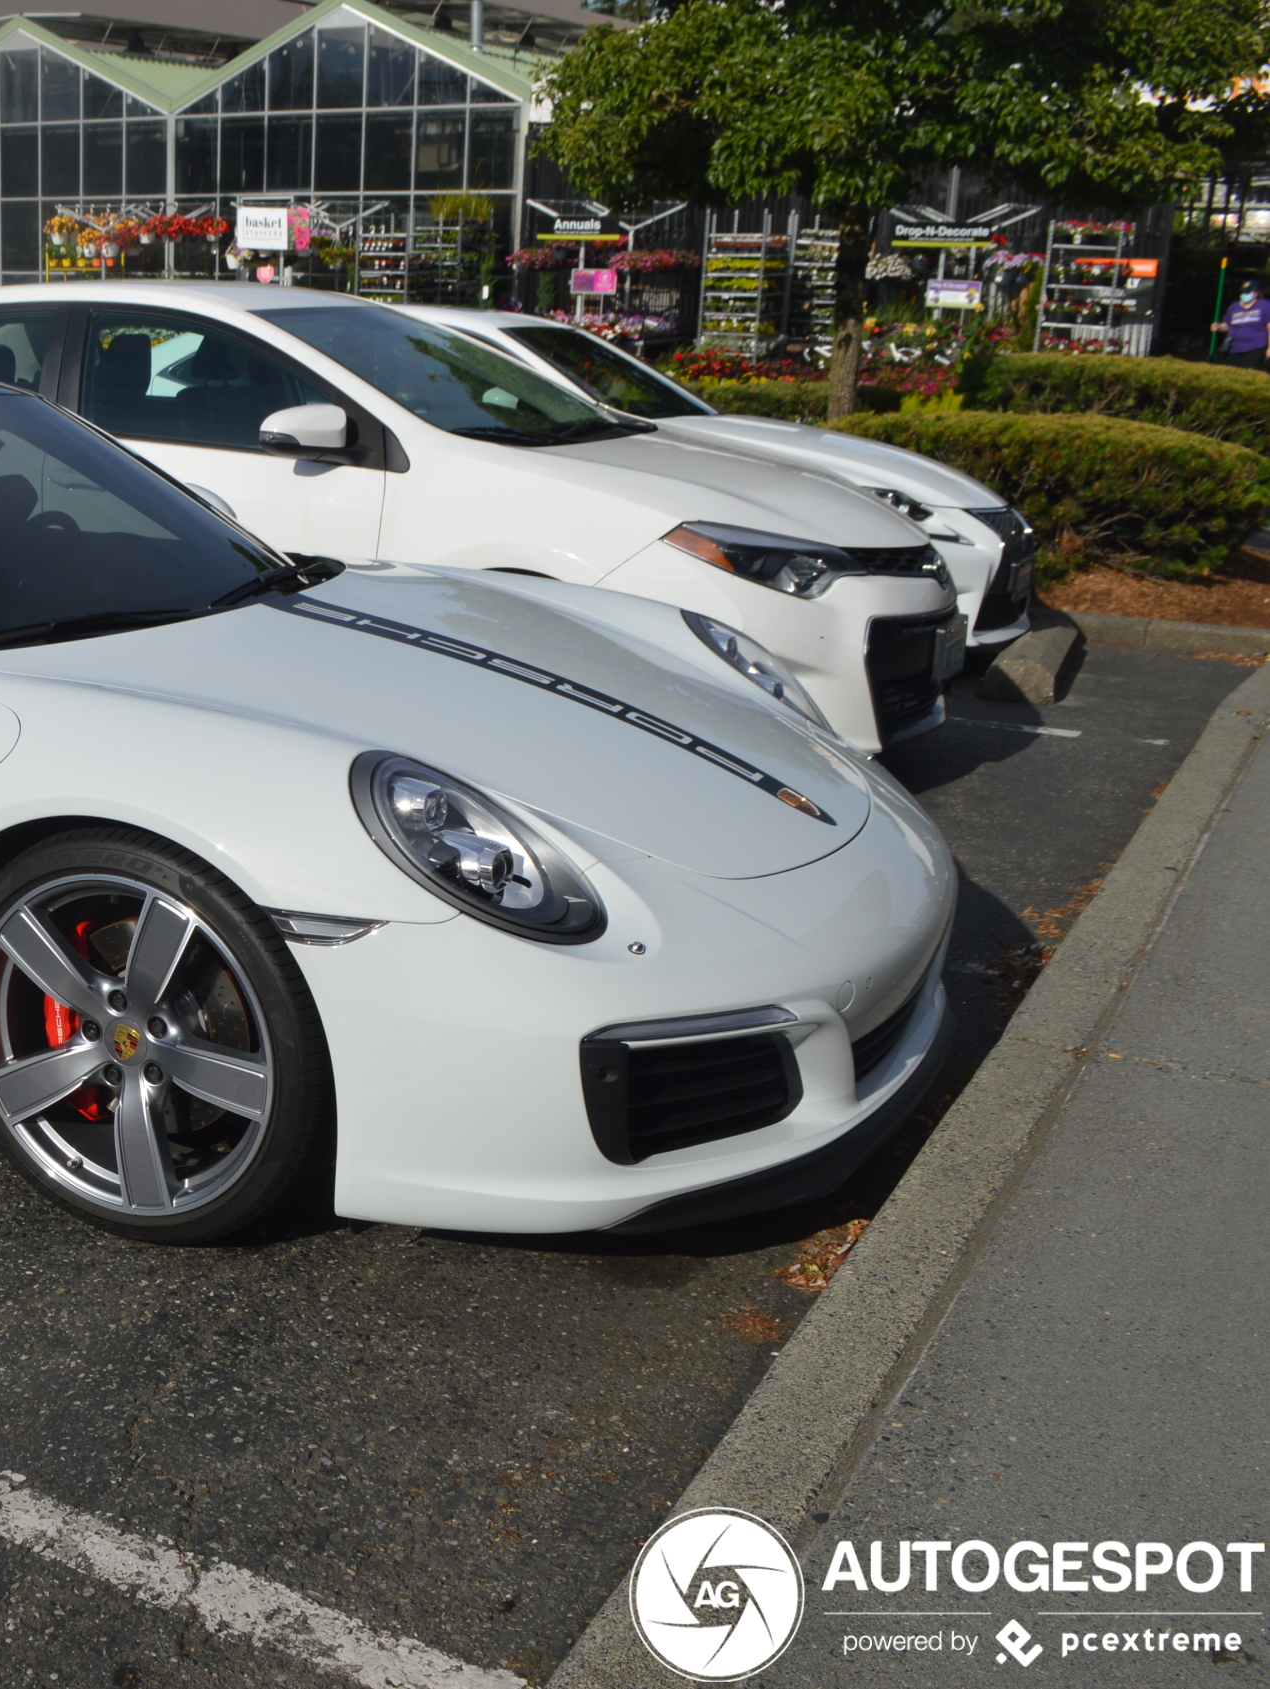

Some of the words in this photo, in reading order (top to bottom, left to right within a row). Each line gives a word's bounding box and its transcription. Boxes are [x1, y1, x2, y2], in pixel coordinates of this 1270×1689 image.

[245, 216, 282, 228] basket
[554, 218, 601, 231] Annuals
[895, 224, 990, 238] Drop-N-Decorate
[293, 602, 764, 783] PORSCHE
[58, 850, 154, 873] ZERO
[54, 1000, 64, 1045] RSCHE
